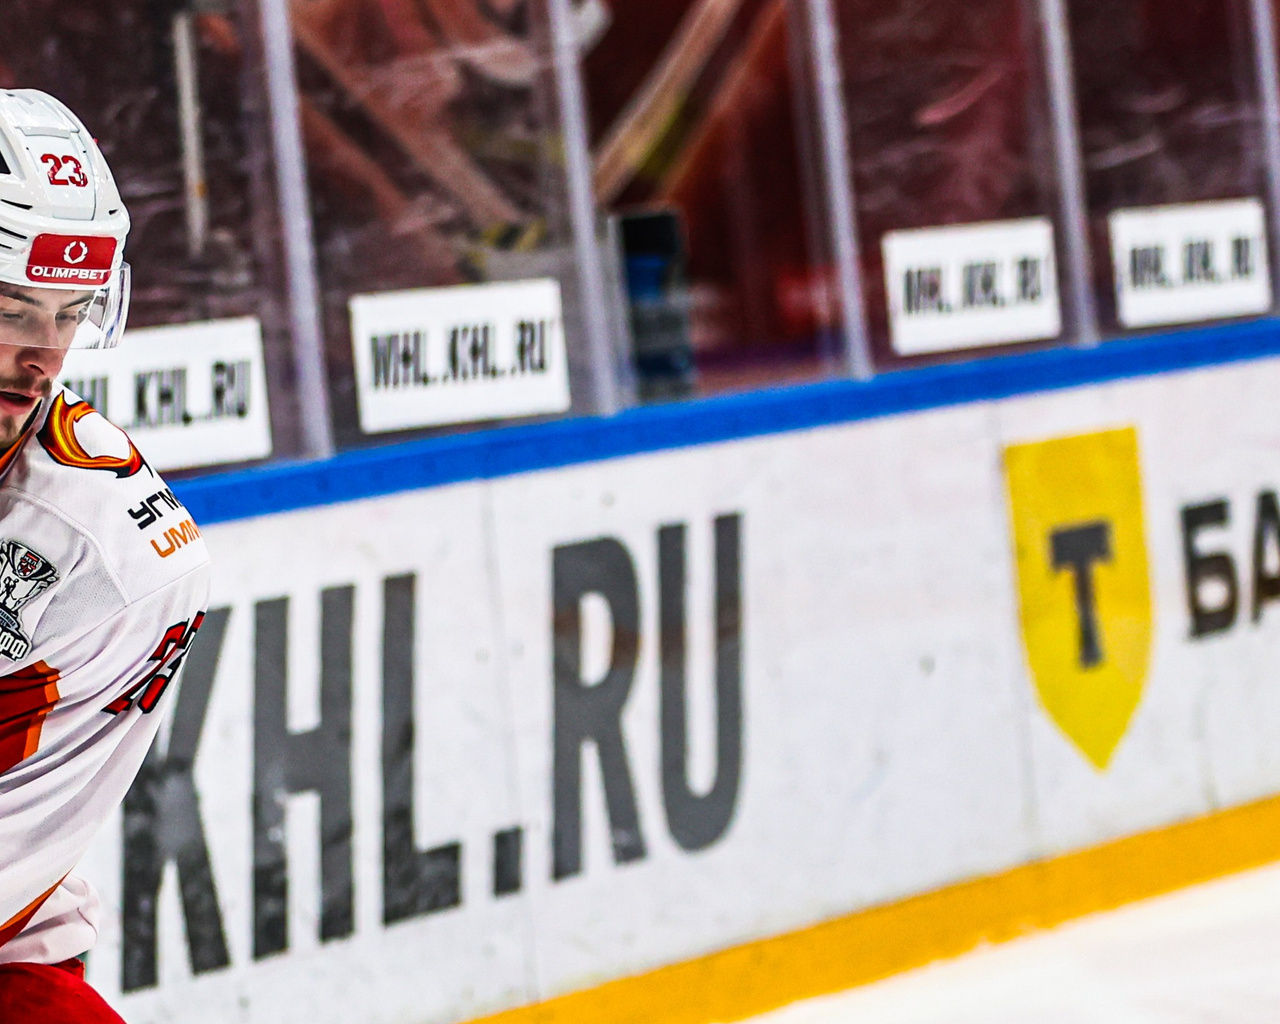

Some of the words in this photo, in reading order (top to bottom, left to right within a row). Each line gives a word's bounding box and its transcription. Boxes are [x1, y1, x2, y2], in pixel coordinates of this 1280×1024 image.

[40, 153, 88, 188] 23
[30, 265, 108, 281] OLIMPBET
[127, 488, 183, 530] УГМ
[150, 518, 203, 558] UMM
[122, 512, 744, 993] KHL.RU
